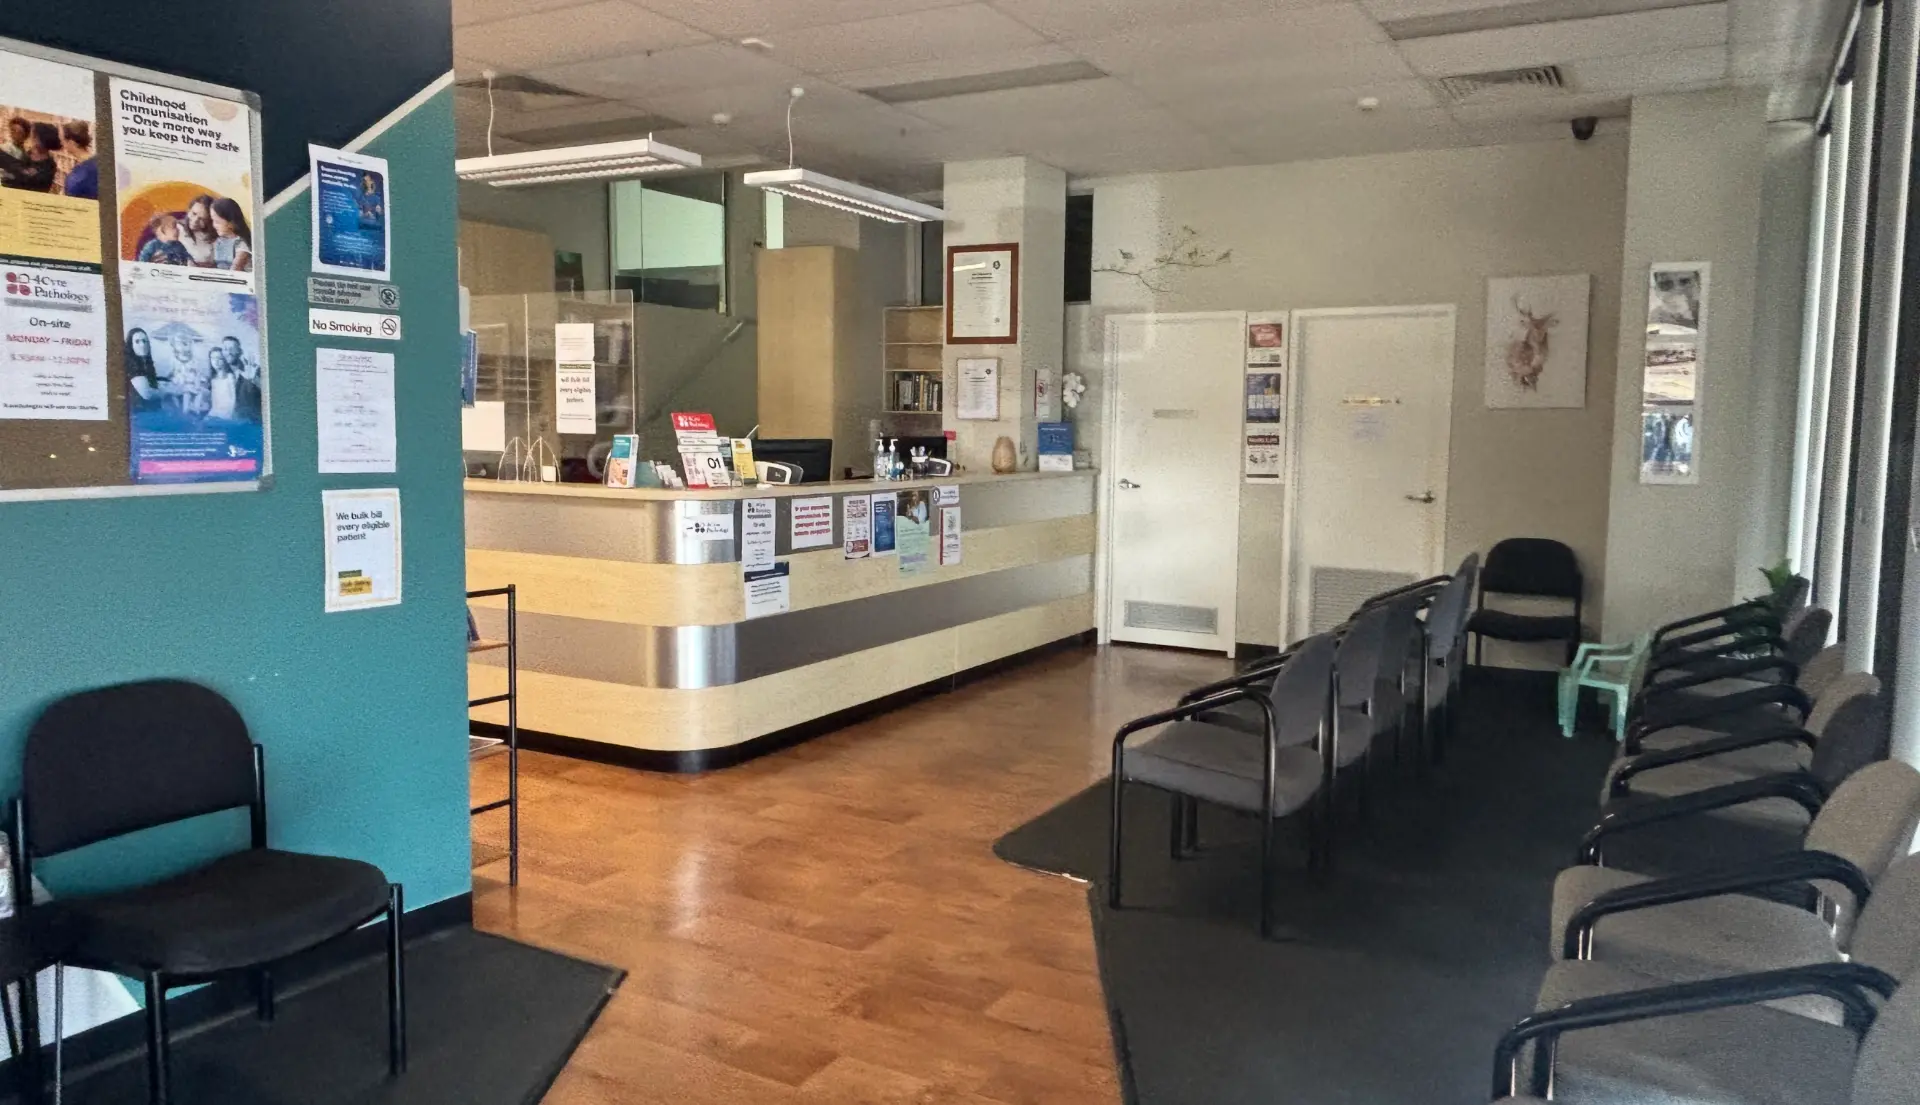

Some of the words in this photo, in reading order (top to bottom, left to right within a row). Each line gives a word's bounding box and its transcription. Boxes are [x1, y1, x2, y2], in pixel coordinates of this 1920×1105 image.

[120, 89, 186, 110] Childhood
[121, 101, 208, 126] Immunisation
[133, 114, 160, 128] One
[162, 122, 194, 134] more
[198, 128, 222, 141] way
[122, 125, 146, 136] you
[149, 128, 178, 144] keep
[182, 134, 212, 148] them
[216, 142, 240, 152] safe
[34, 286, 91, 304] Pathology
[29, 316, 72, 328] On-site
[312, 320, 326, 330] No
[329, 320, 372, 336] Smoking
[6, 334, 50, 344] MONDAY
[60, 337, 92, 346] FRIDAY
[708, 456, 722, 468] 01
[336, 512, 350, 520] We
[351, 511, 370, 520] bulk
[370, 510, 382, 518] bill
[337, 523, 360, 532] every
[362, 520, 391, 531] eligible
[337, 532, 367, 544] patient
